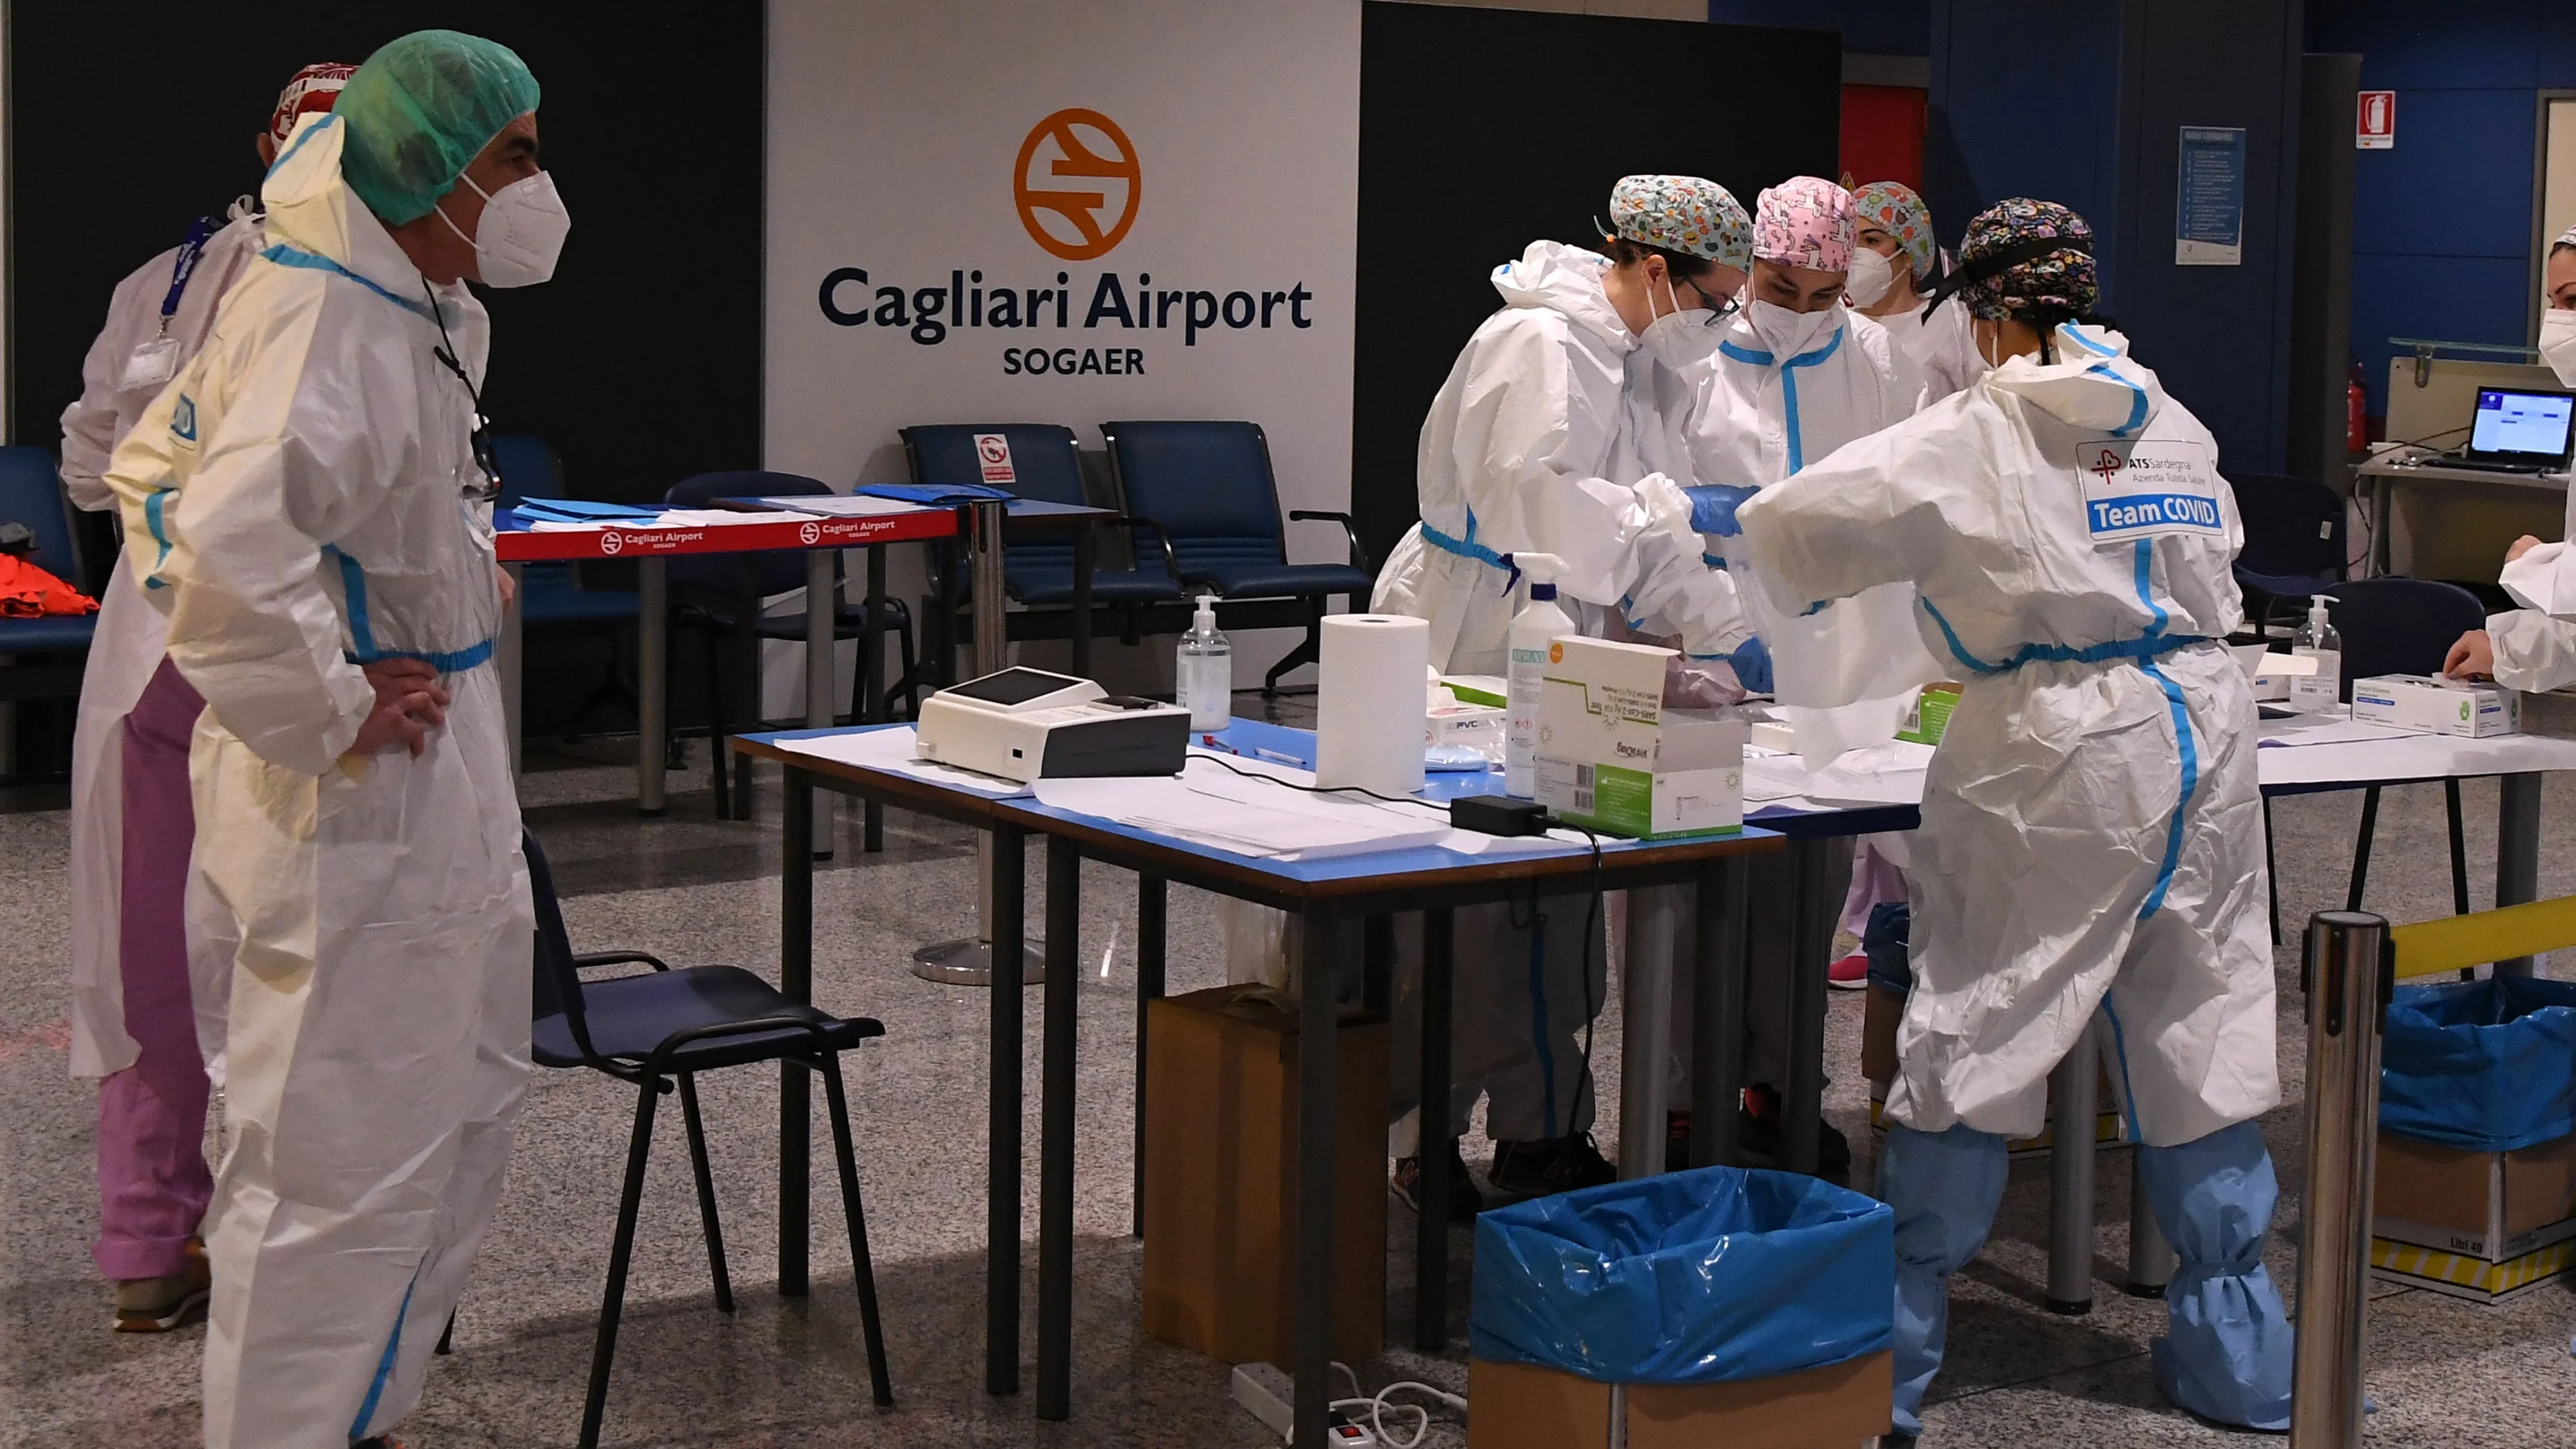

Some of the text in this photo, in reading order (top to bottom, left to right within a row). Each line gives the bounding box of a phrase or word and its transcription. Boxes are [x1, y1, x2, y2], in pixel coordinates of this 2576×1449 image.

[818, 267, 1313, 347] Cagliari Airport
[1004, 347, 1146, 376] SOGAER
[2133, 474, 2164, 483] Azienda
[2094, 497, 2214, 528] Team COVID
[822, 521, 896, 535] Cagliari Airport
[625, 532, 703, 545] Cagliari Airport
[1456, 720, 1478, 729] PVC
[2451, 1236, 2482, 1254] Litri 40
